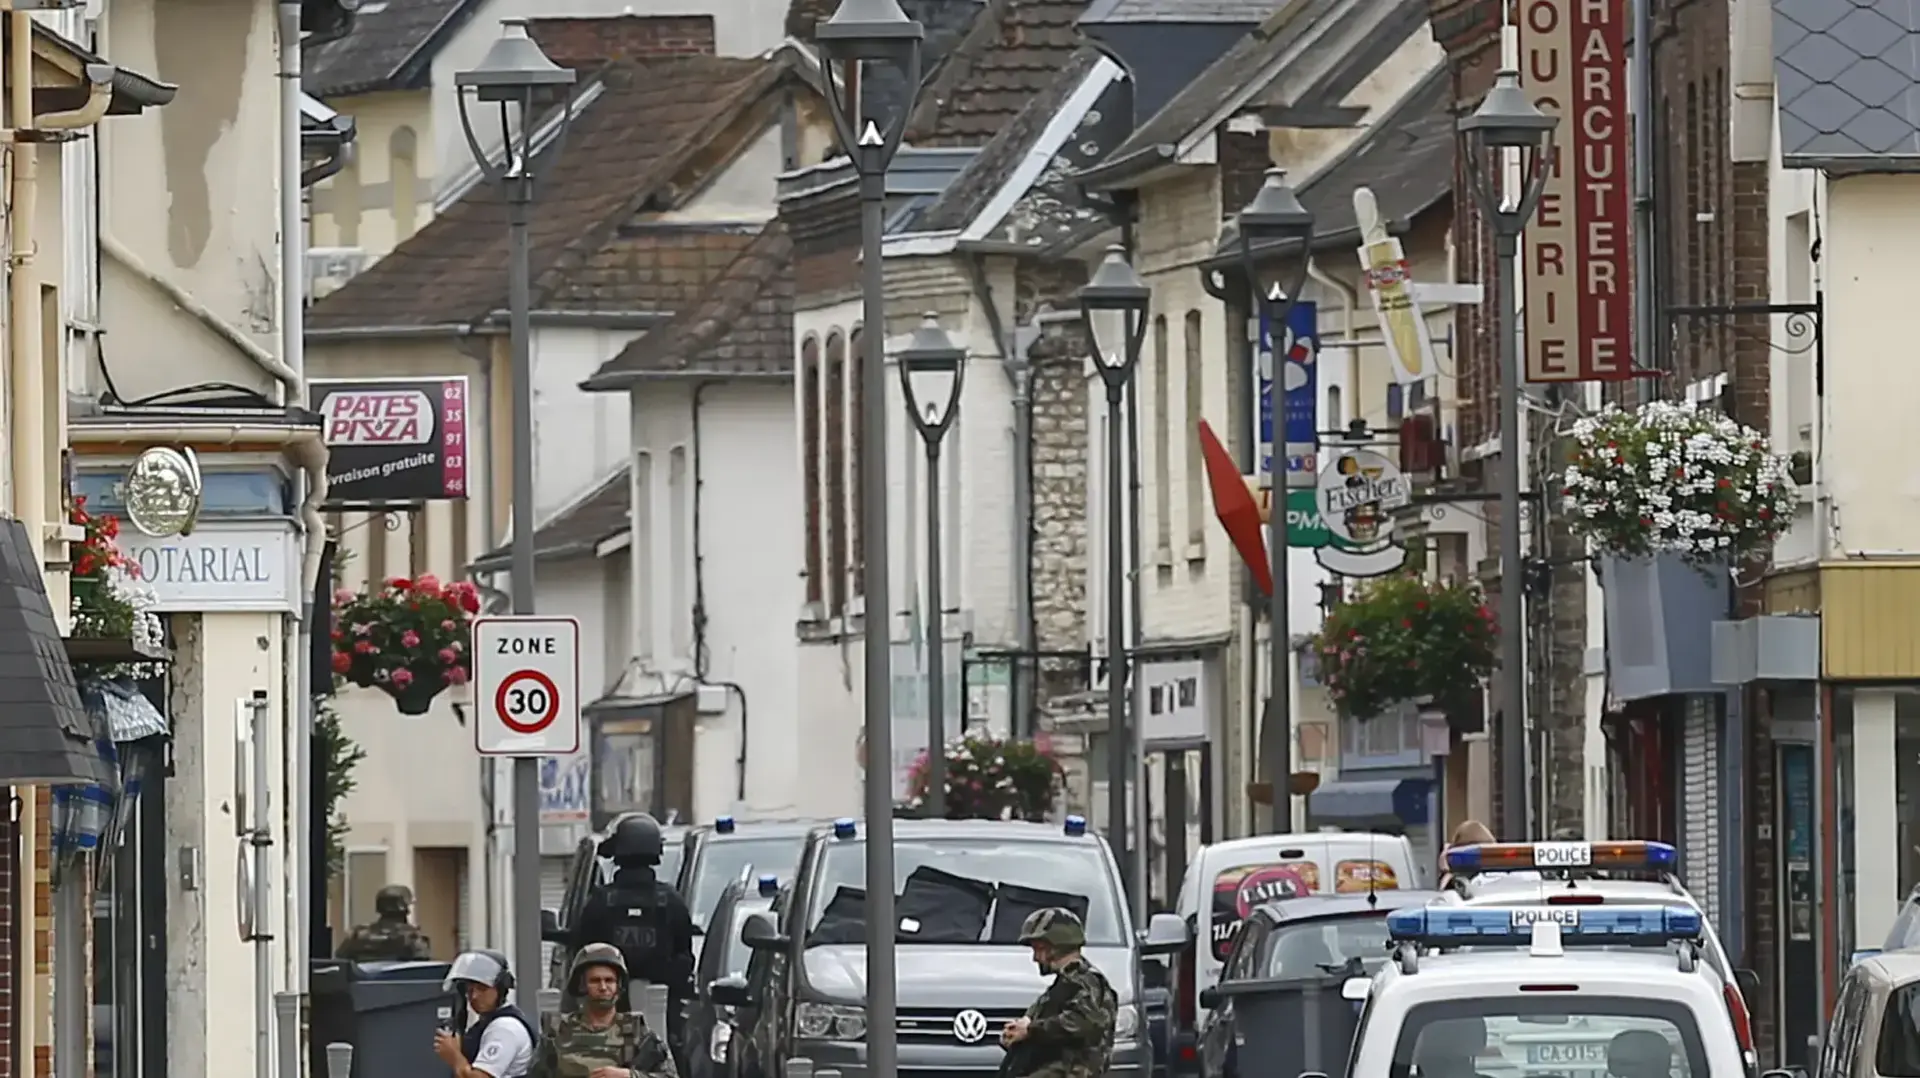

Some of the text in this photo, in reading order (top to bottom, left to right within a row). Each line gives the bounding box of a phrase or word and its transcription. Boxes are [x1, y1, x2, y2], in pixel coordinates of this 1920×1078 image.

[1580, 0, 1616, 372] HARCUTERIE
[329, 418, 418, 442] PIZZA
[443, 387, 462, 491] 02 35 91 03 46
[328, 452, 435, 486] ivraison gratuite
[1326, 477, 1397, 514] Fischer
[1287, 511, 1330, 530] PM
[497, 638, 556, 654] ZONE
[509, 689, 547, 715] 30
[1537, 848, 1589, 863] POLICE
[1515, 912, 1575, 924] POLICE
